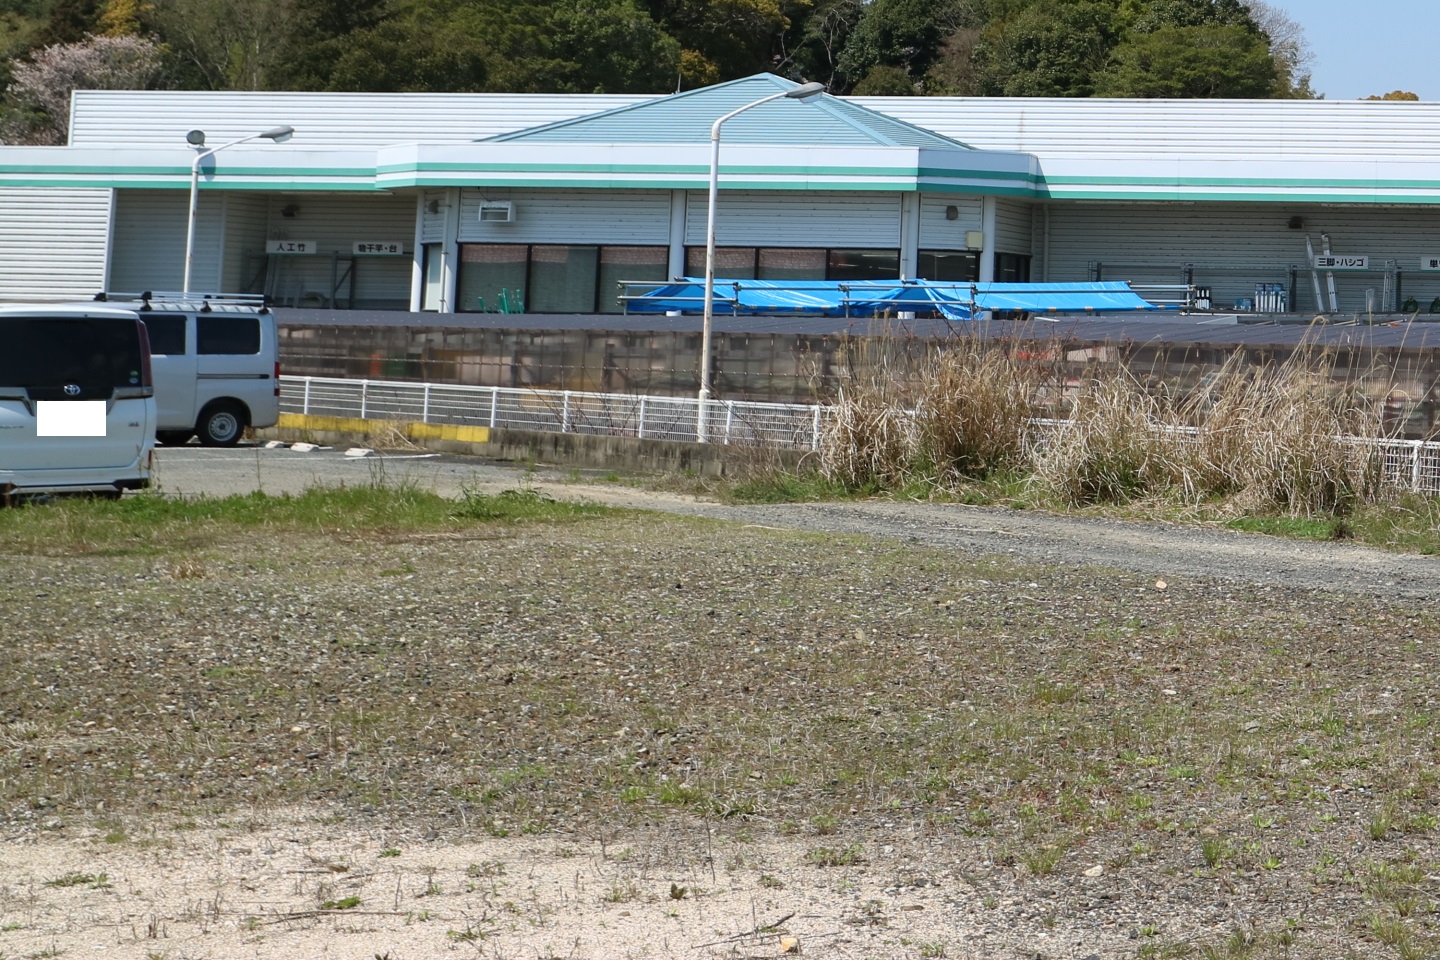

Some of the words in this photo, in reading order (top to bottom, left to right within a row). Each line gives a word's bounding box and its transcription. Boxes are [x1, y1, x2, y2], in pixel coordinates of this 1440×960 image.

[276, 242, 306, 253] 人工竹
[1317, 257, 1365, 267] 三脚・ハシゴ
